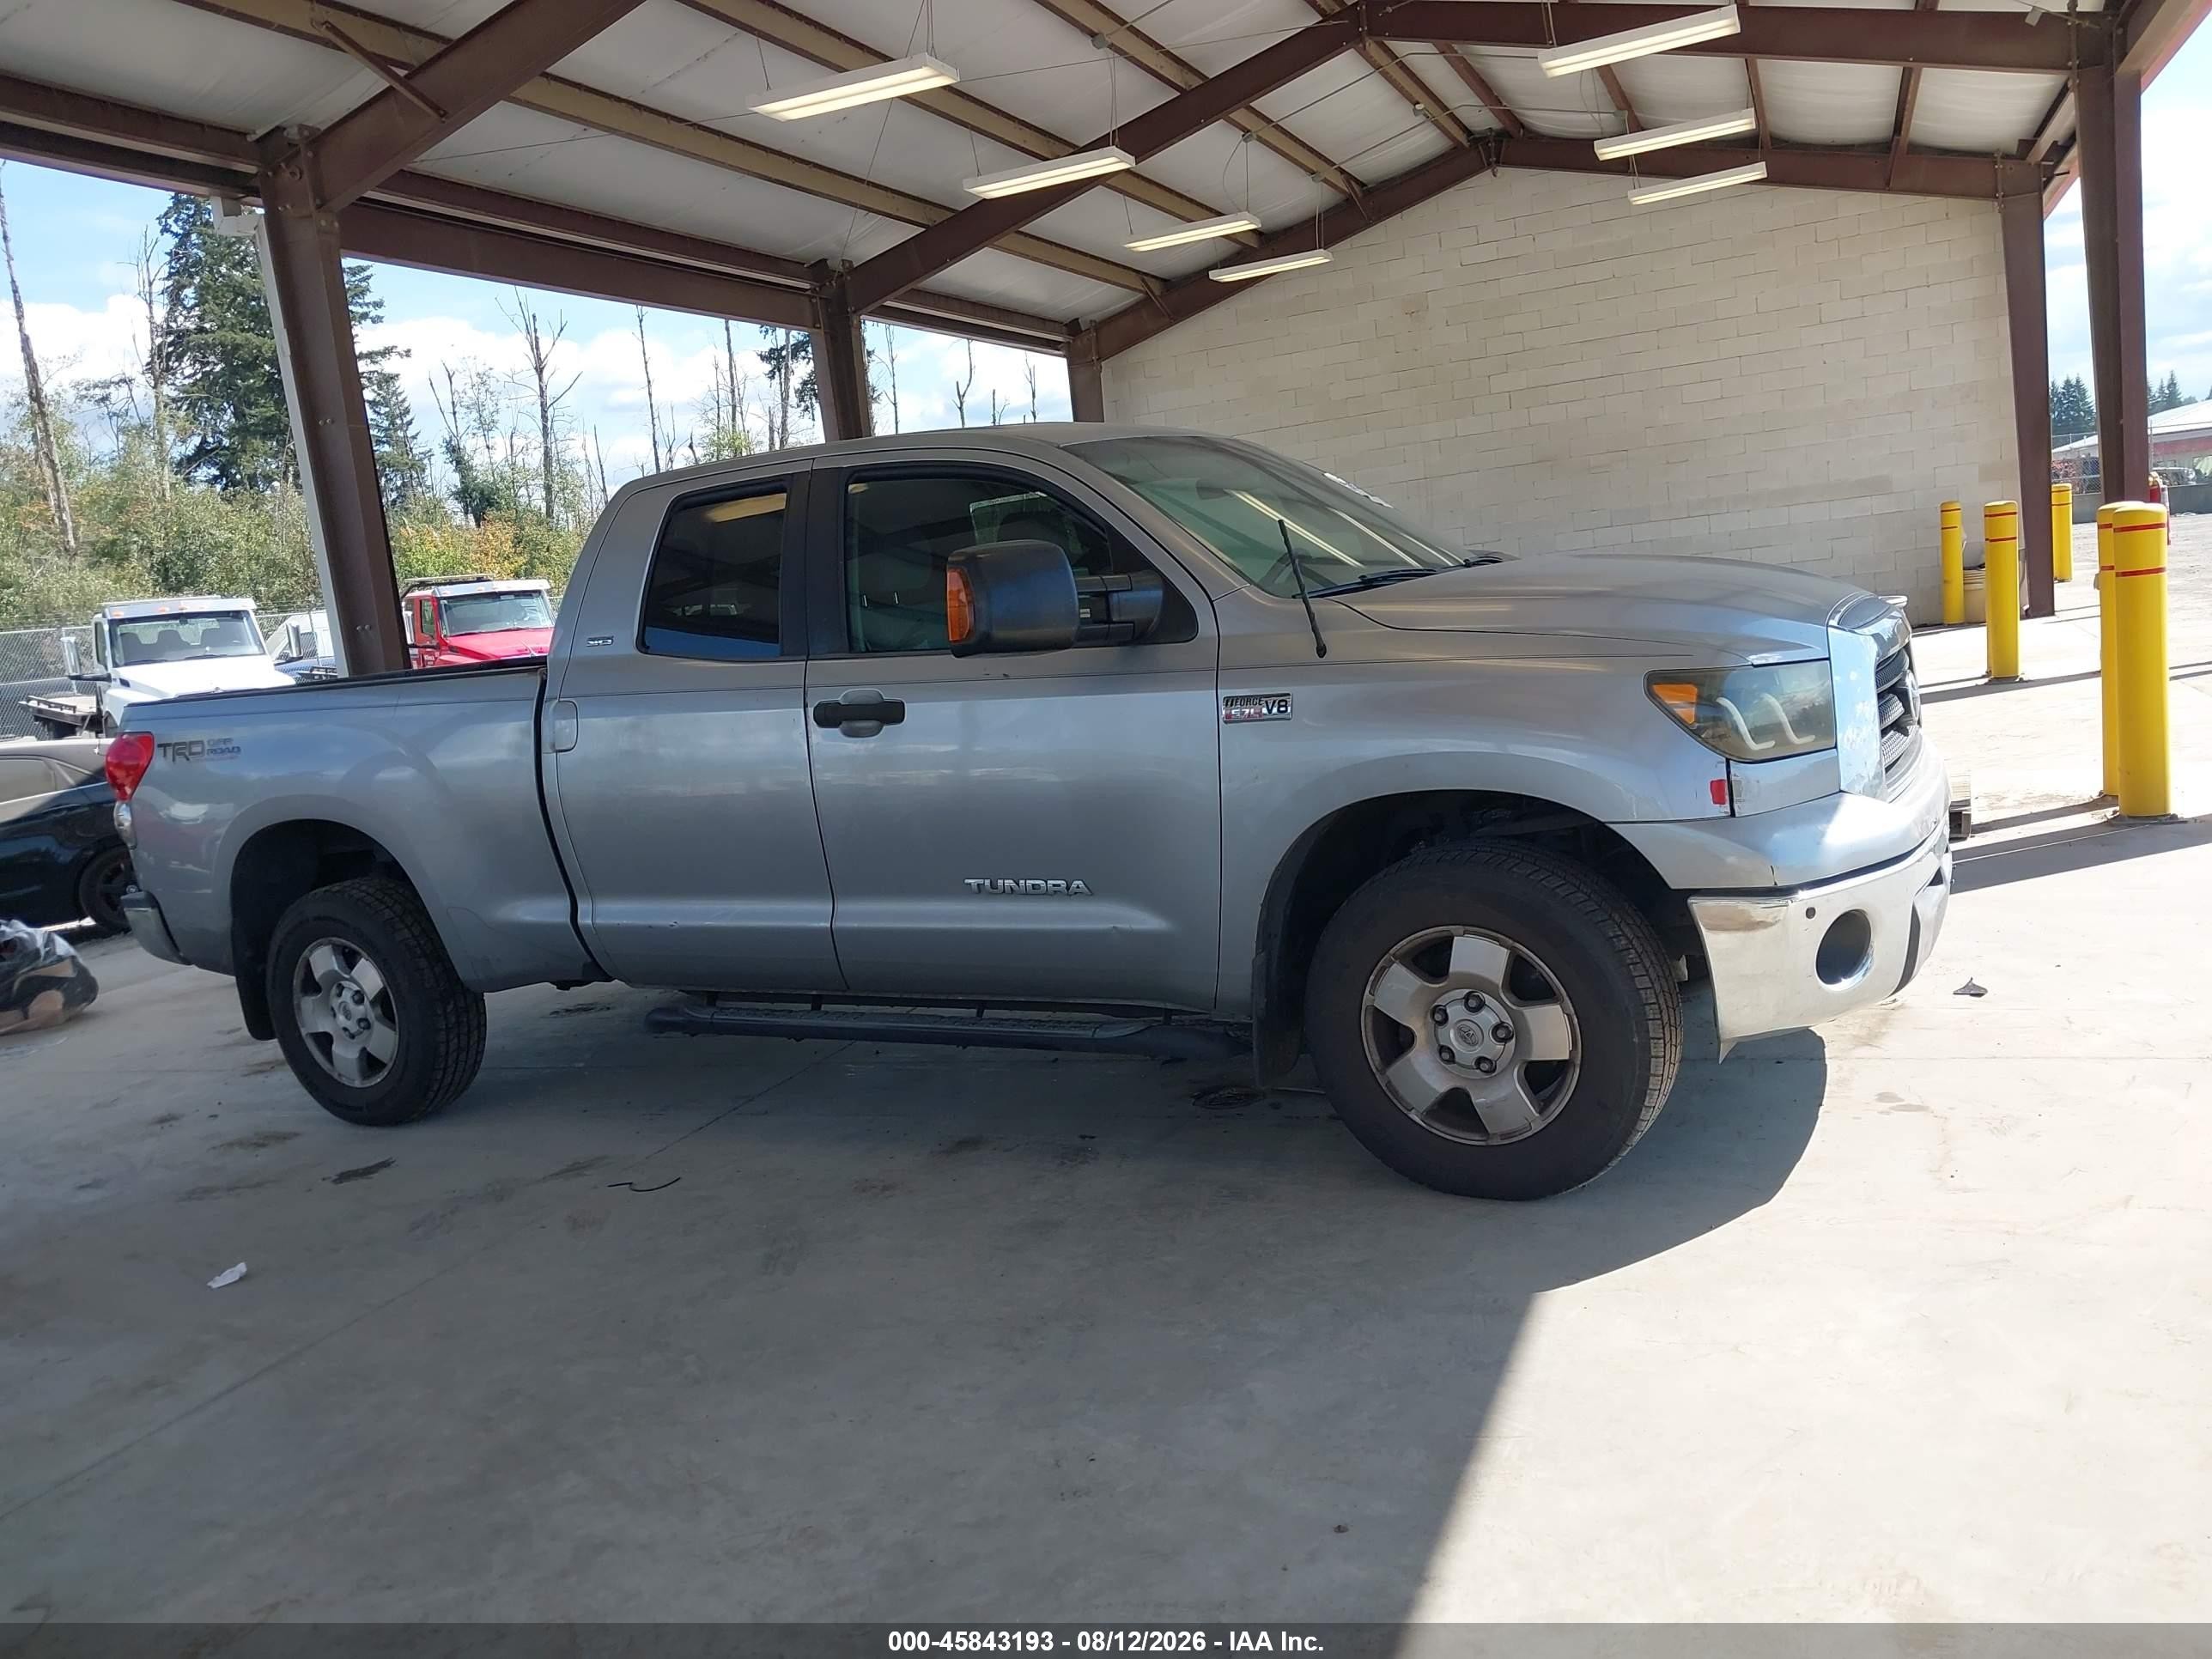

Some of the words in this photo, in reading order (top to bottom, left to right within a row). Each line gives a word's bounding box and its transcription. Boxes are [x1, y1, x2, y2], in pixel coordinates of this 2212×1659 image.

[1264, 699, 1289, 715] V8
[157, 740, 205, 763] TRD
[964, 878, 1093, 896] TUNDRA
